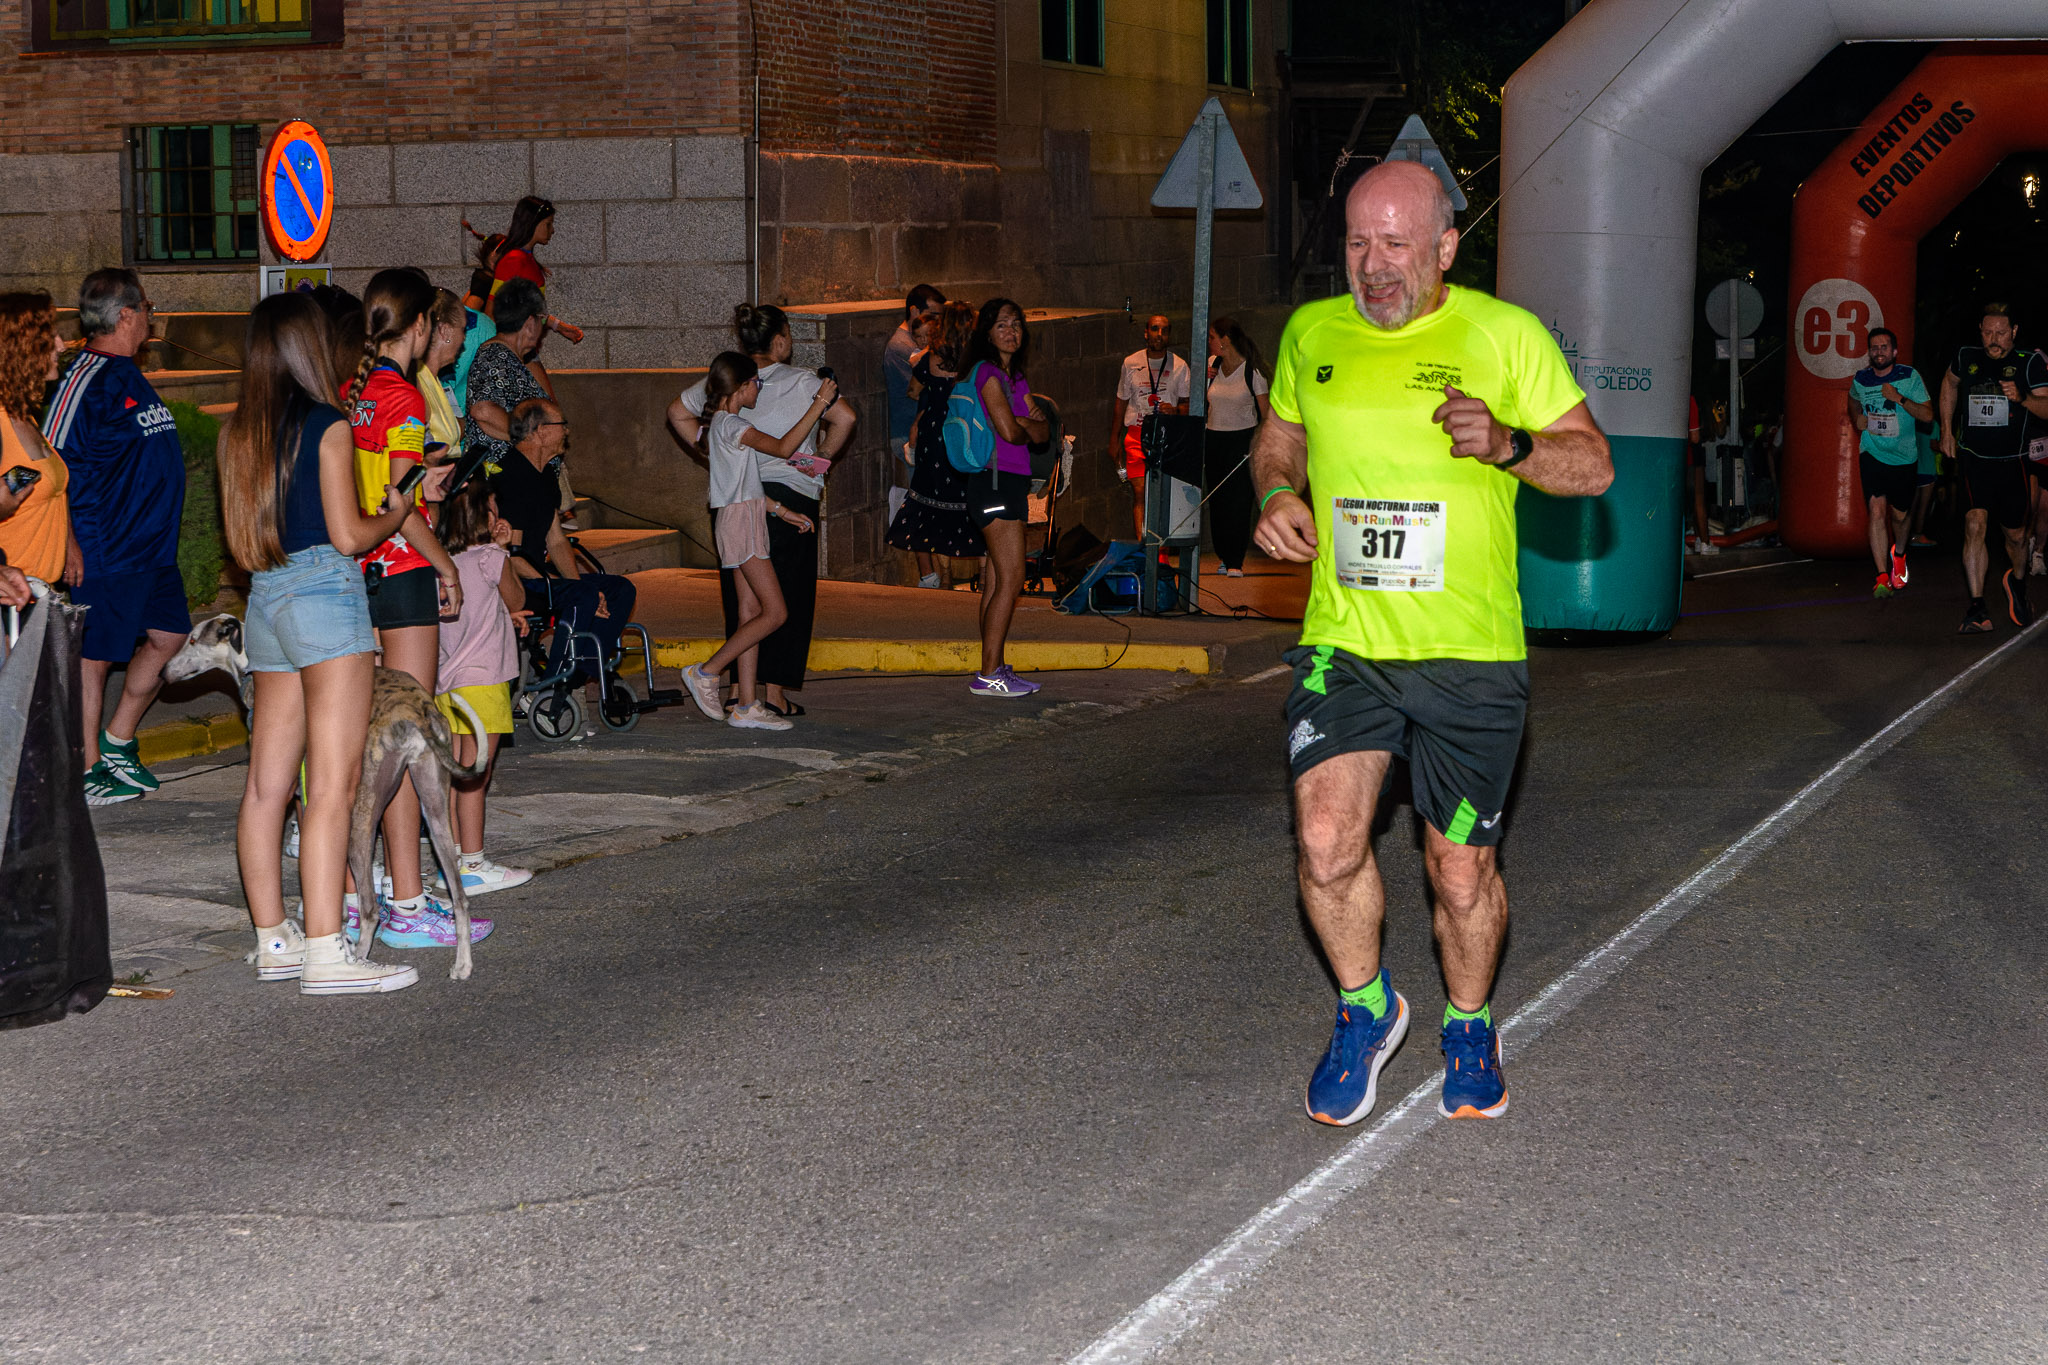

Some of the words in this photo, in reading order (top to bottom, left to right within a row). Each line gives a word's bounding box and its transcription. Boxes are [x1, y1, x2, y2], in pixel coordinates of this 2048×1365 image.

[1849, 91, 1933, 178] EVENTOS
[1857, 100, 1975, 219] DEPORTIVOS
[1803, 300, 1870, 358] e3
[1641, 367, 1653, 376] DE
[1584, 374, 1652, 391] OLEDO
[136, 402, 175, 428] adida
[1981, 405, 1994, 416] 40
[1877, 420, 1887, 430] 36
[1343, 498, 1365, 510] LEGUA
[1365, 499, 1411, 512] NOCTURNA
[1361, 527, 1406, 560] 317
